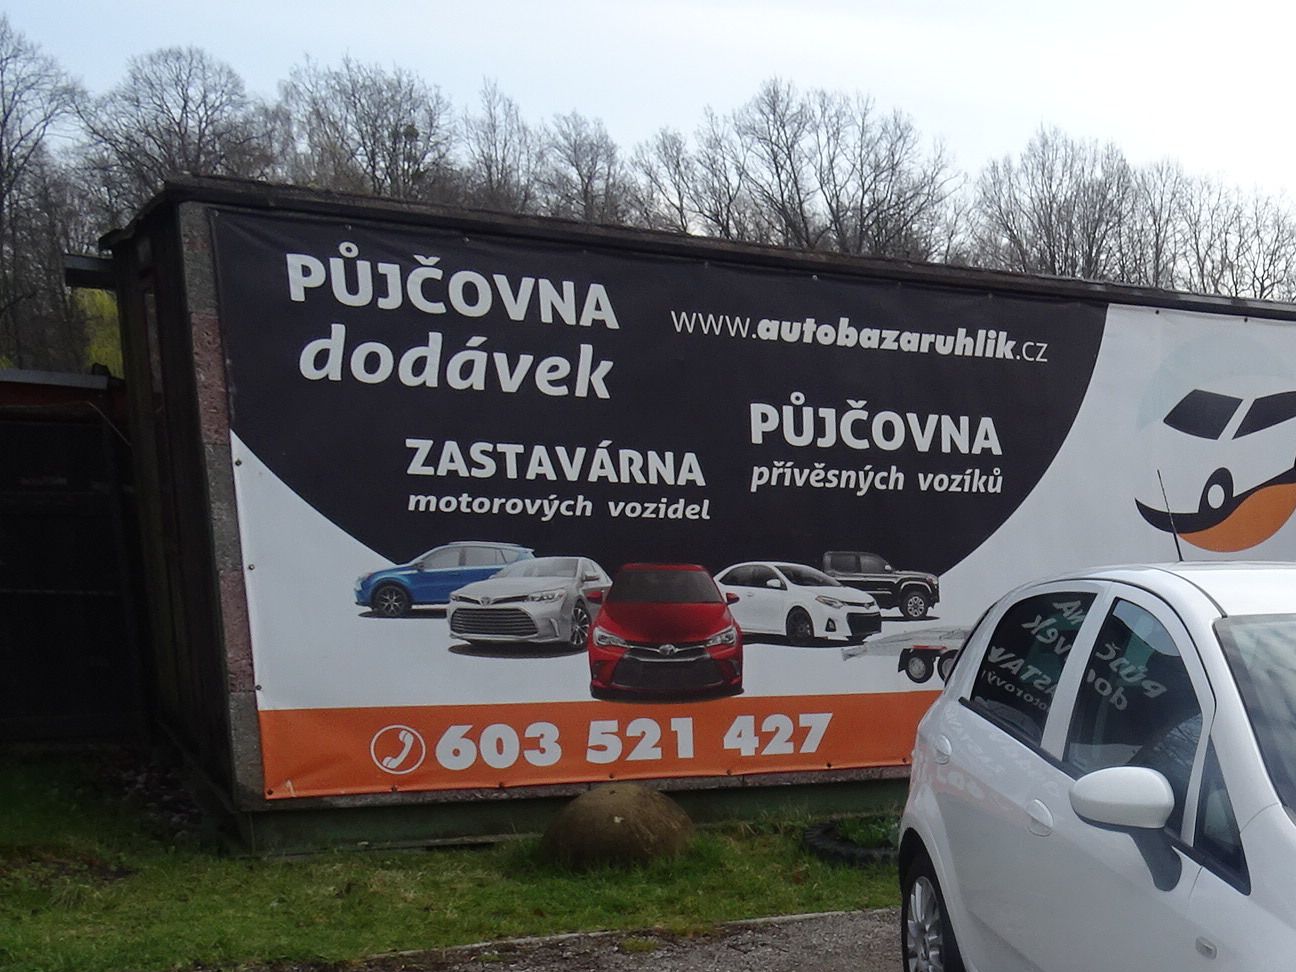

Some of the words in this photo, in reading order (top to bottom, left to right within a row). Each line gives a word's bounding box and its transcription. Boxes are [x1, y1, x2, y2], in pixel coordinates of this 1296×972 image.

[286, 241, 620, 330] PŮJČOVNA
[299, 323, 614, 399] dodávek
[750, 391, 1002, 456] PŮJČOVNA
[405, 438, 706, 486] ZASTAVÁRNA
[750, 461, 904, 496] přívěsných
[917, 467, 1003, 493] vozíků
[407, 493, 593, 521] motorových
[607, 498, 710, 520] vozidel
[435, 722, 563, 770] 603
[586, 717, 695, 764] 521
[722, 713, 833, 757] 427
